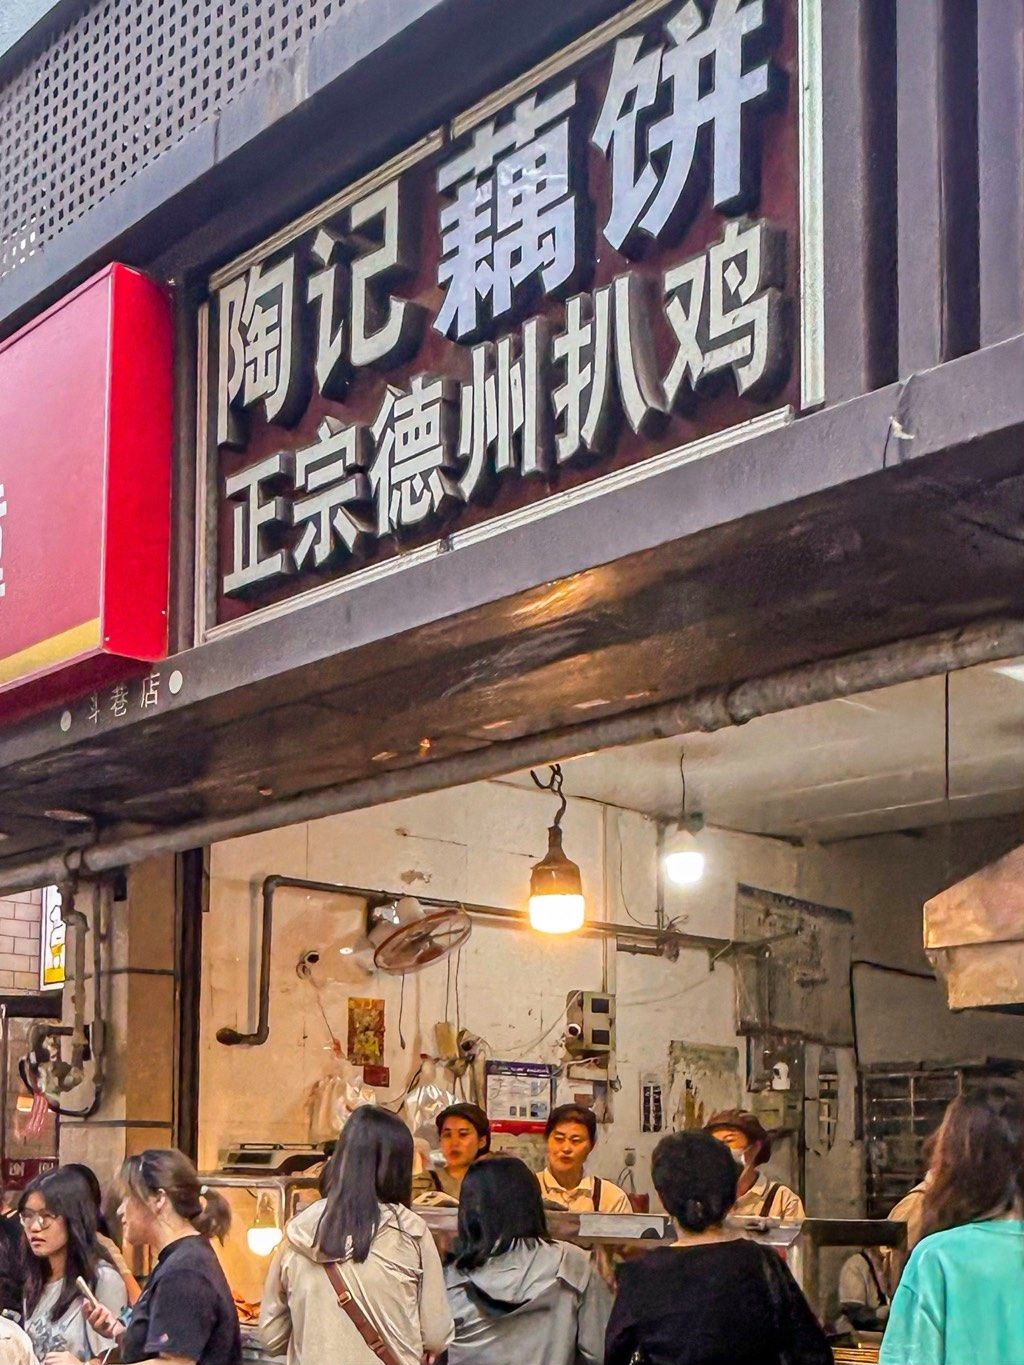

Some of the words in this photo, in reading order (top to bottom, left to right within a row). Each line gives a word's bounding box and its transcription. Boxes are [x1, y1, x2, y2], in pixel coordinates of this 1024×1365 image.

[217, 0, 769, 446] 陶记藕饼
[223, 220, 771, 595] 正宗德州扒鸡
